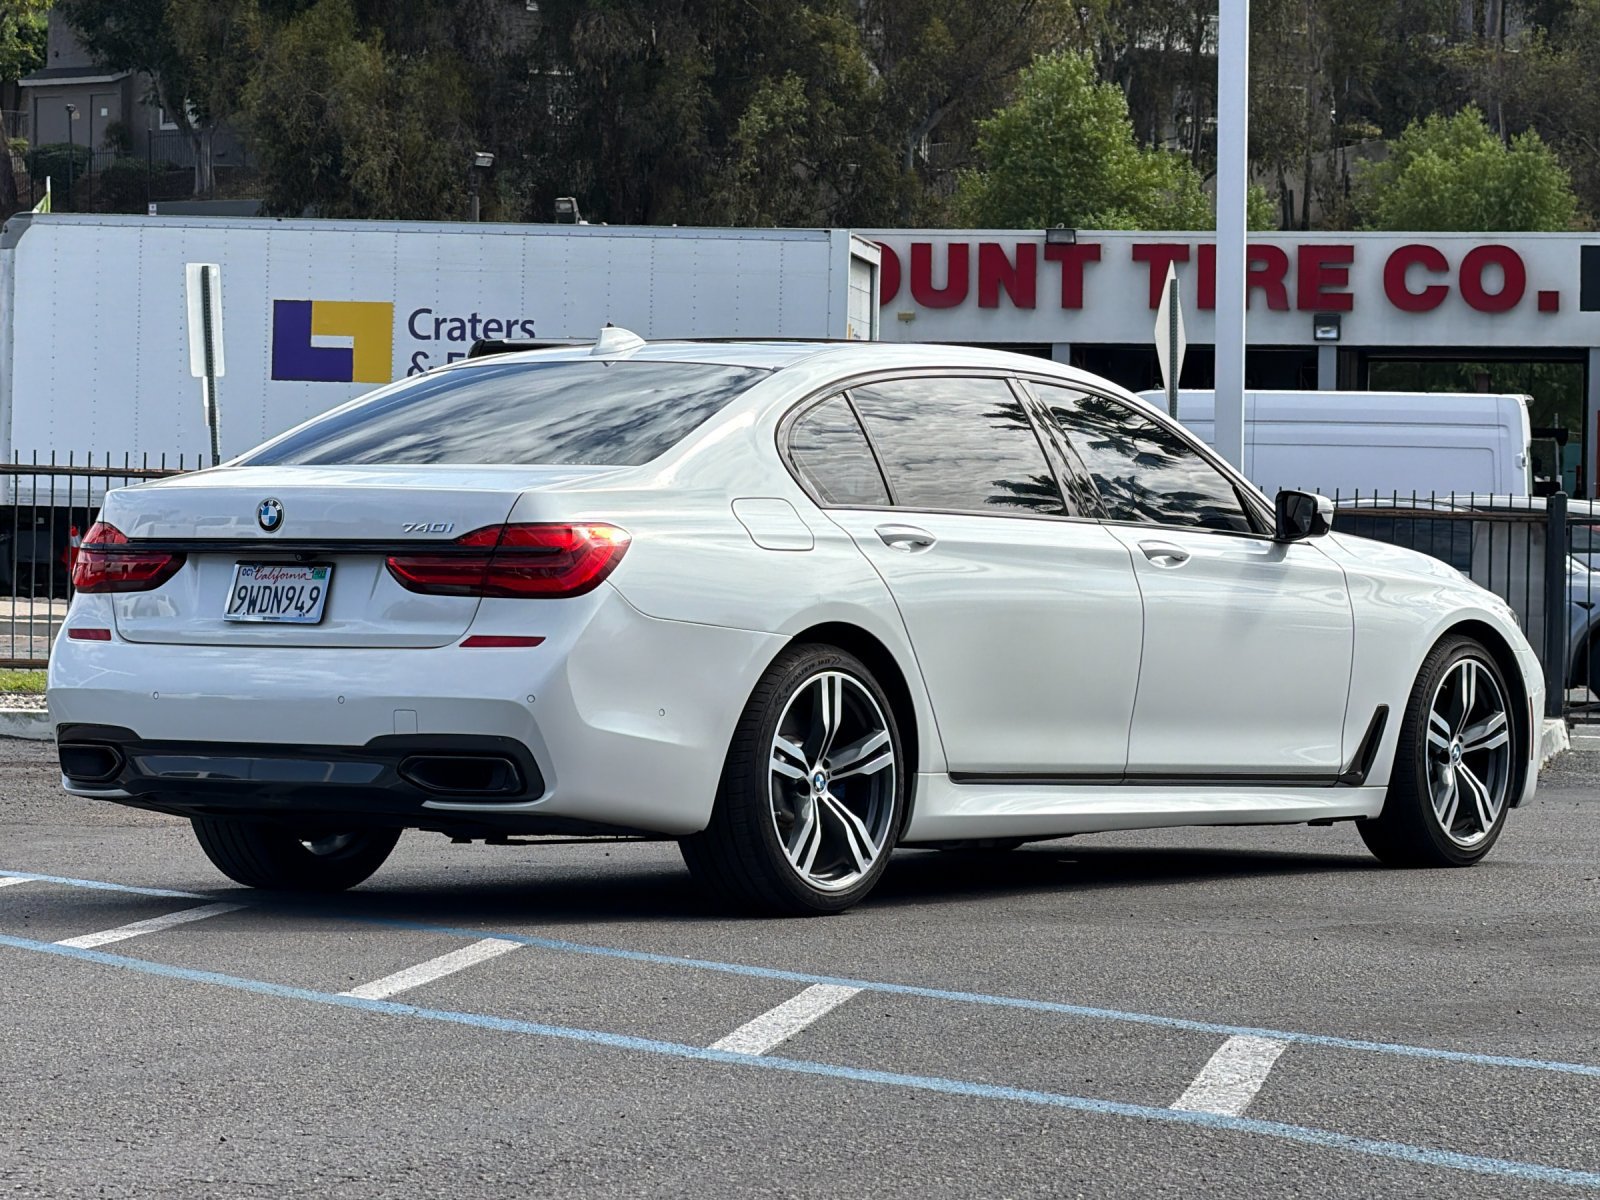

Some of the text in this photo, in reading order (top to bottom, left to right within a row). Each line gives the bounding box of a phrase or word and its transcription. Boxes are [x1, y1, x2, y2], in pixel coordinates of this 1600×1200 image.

[1132, 243, 1355, 311] TIRE
[1383, 243, 1560, 313] CO.
[408, 307, 536, 342] Craters
[254, 567, 312, 585] California
[233, 585, 321, 615] 9WDN949
